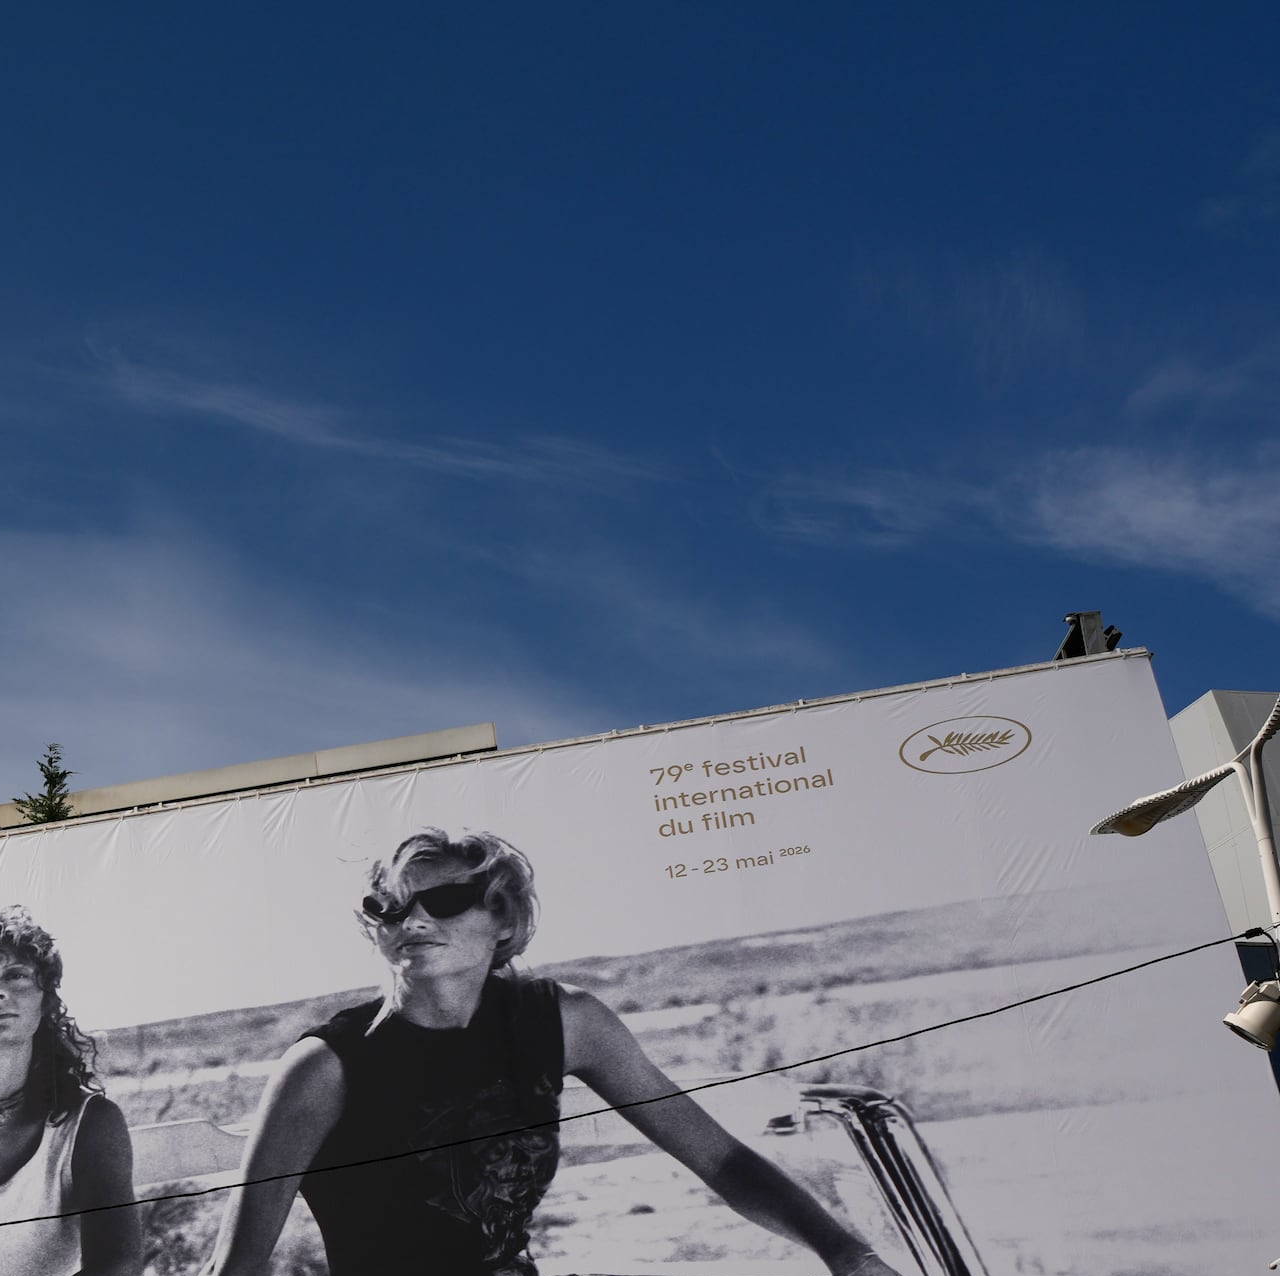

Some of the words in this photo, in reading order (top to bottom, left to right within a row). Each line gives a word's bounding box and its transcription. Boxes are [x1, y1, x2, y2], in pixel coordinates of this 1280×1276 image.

[701, 745, 807, 779] festival
[653, 768, 835, 812] international
[657, 815, 695, 838] du
[701, 808, 756, 831] film
[734, 849, 776, 869] mai
[778, 844, 811, 859] 2026
